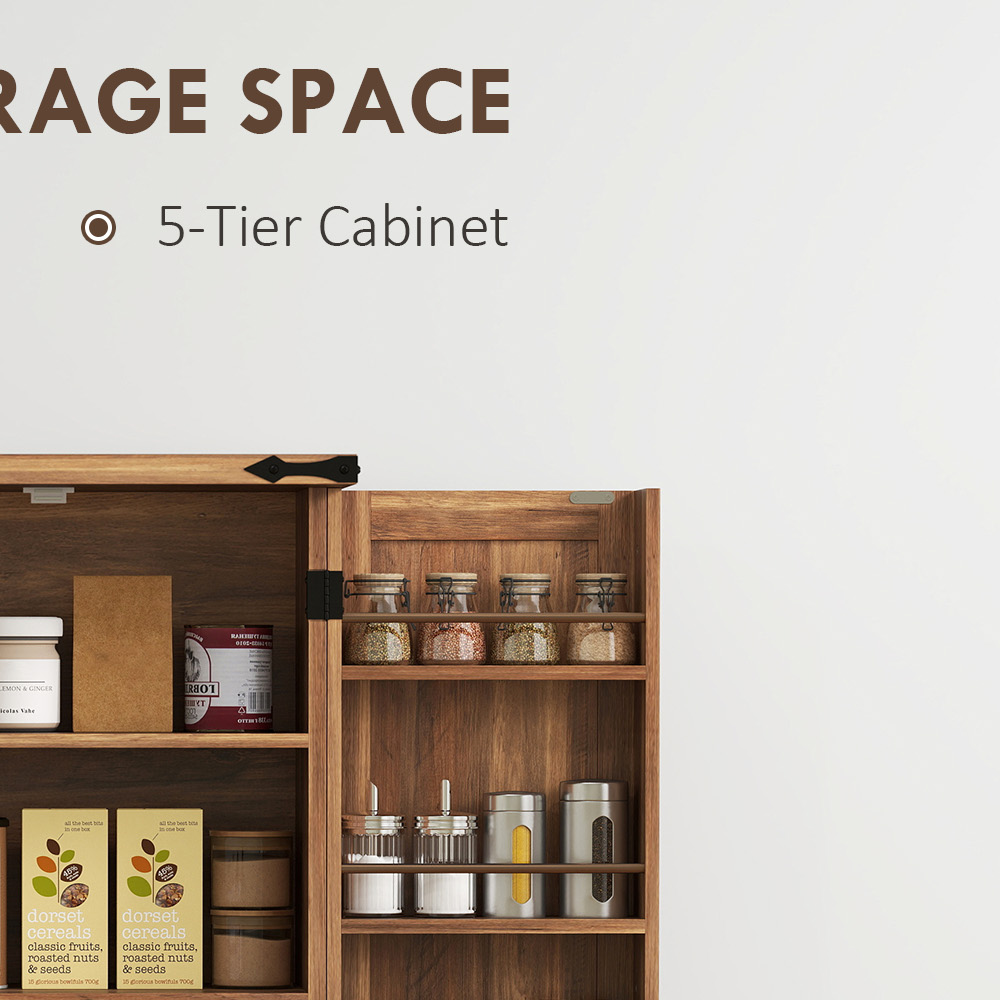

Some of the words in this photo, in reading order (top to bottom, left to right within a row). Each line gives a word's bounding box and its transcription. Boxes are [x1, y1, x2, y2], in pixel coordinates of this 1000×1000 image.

[27, 908, 84, 923] dorset
[122, 908, 180, 923] dorset
[27, 925, 92, 939] cereals
[122, 925, 186, 939] cereals
[28, 942, 66, 951] classic
[69, 942, 103, 952] fruits,
[122, 942, 160, 951] classic
[164, 942, 198, 952] fruits,
[28, 953, 70, 962] roasted
[73, 954, 100, 962] nuts
[123, 953, 165, 962] roasted
[168, 954, 194, 962] nuts
[28, 964, 38, 974] &
[40, 965, 72, 974] seeds
[122, 964, 132, 974] &
[135, 965, 166, 974] seeds
